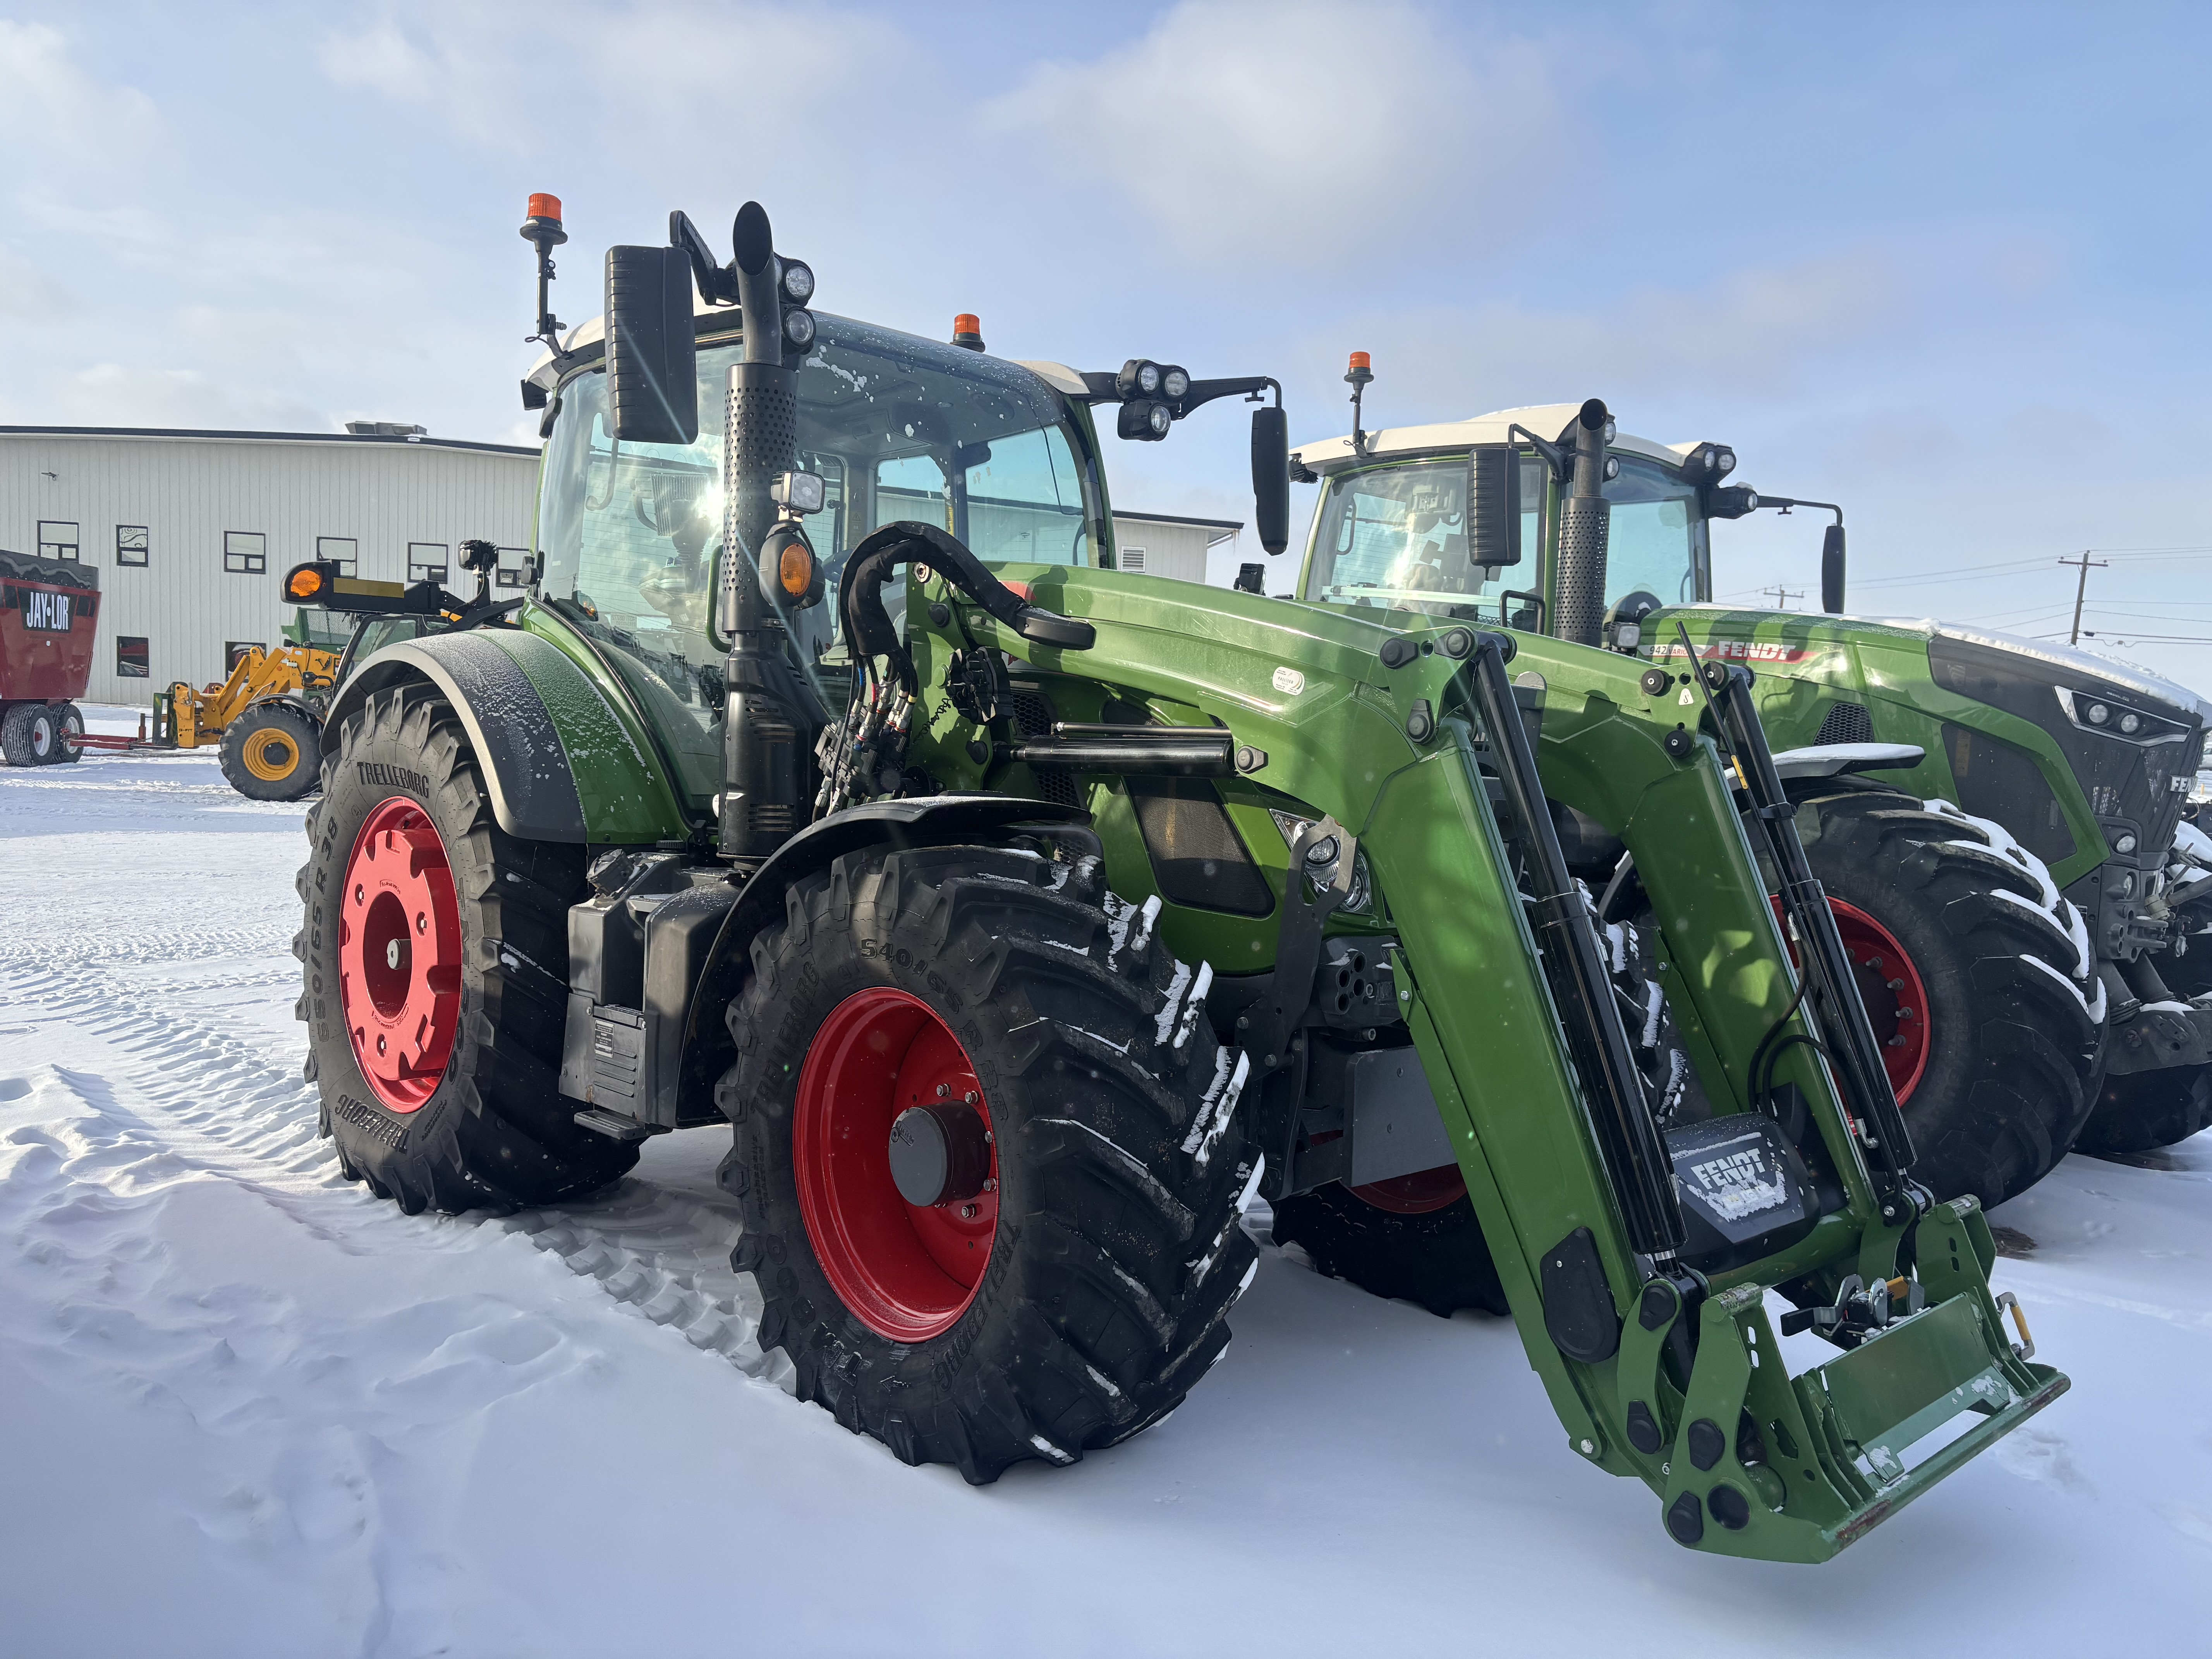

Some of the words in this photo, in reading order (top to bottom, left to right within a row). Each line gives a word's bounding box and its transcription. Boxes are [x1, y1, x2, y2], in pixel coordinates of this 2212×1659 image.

[1650, 646, 1667, 655] 942
[1718, 641, 1796, 660] FENDT
[357, 761, 429, 799] TRELLEBORG
[321, 815, 338, 862] 38
[316, 867, 328, 895] R
[311, 900, 330, 1042] 650/65
[750, 961, 819, 1118] TRELLEBORG
[334, 1094, 411, 1155] TRELLEBORG
[1690, 1147, 1767, 1189] FENDT
[934, 1220, 1021, 1392] TRELLEBORG
